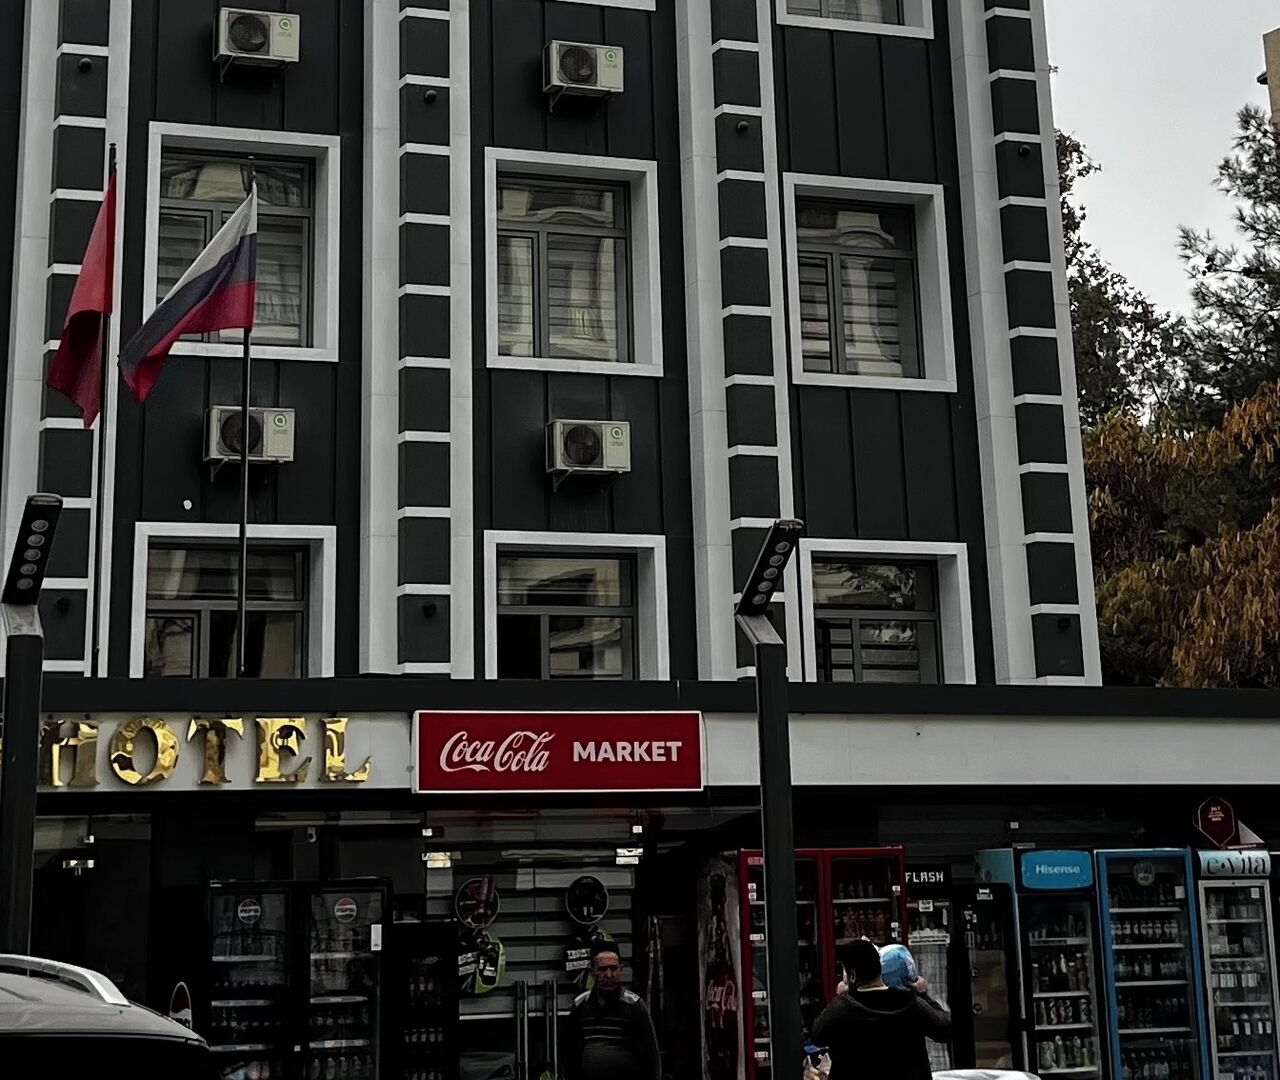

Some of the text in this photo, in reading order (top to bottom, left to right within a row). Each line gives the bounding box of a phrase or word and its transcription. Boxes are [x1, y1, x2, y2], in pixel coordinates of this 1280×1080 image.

[40, 717, 372, 786] HOTEL
[573, 740, 683, 763] MARKET
[904, 871, 945, 883] FLASH
[1035, 863, 1082, 875] Hisense
